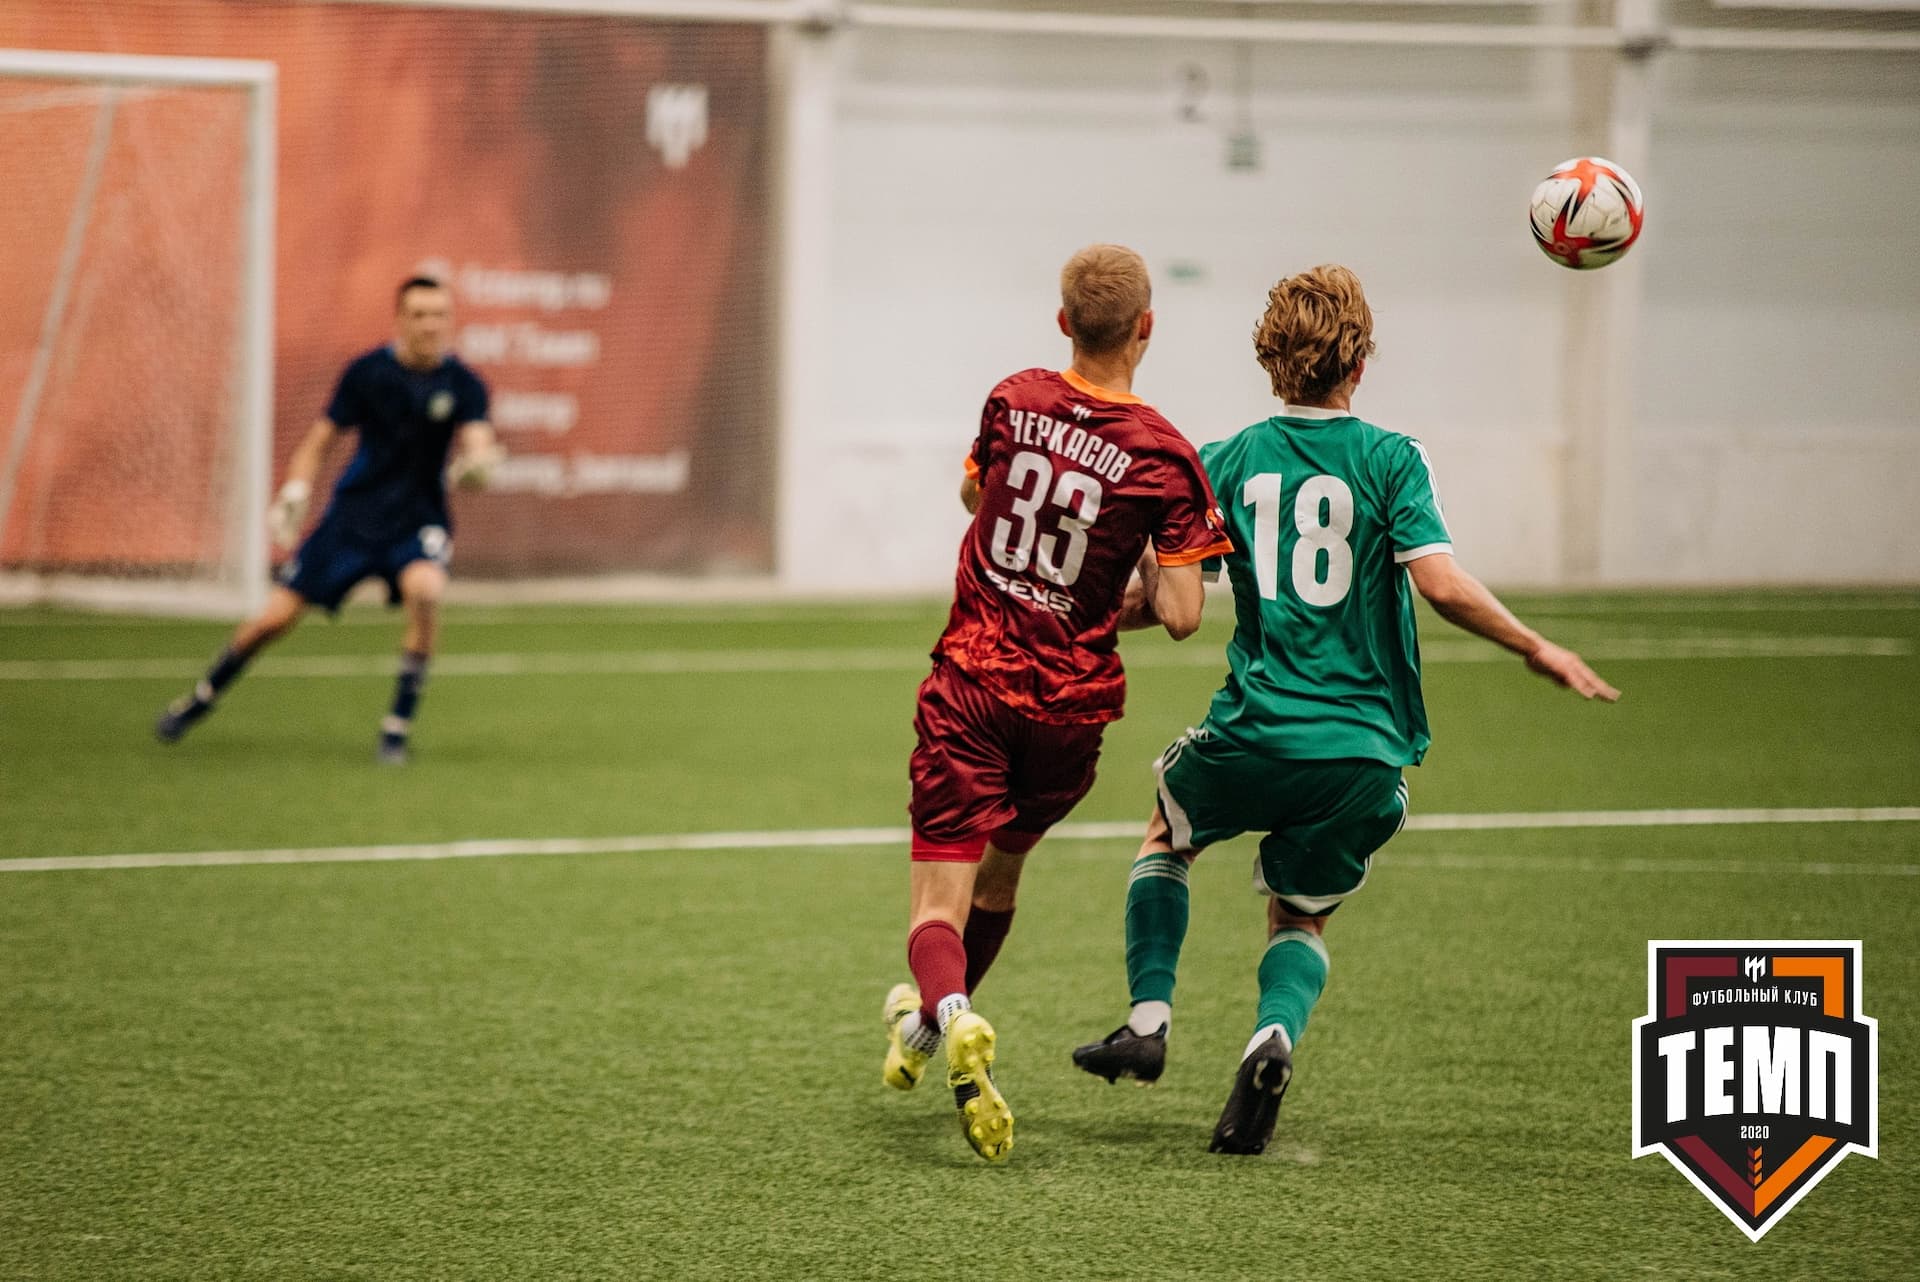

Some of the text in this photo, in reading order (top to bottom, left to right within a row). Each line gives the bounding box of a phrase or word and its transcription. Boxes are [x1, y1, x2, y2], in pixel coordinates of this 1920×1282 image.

[1009, 409, 1133, 484] ЧЕРКАСОВ
[990, 451, 1103, 587] 33
[1243, 472, 1354, 608] 18
